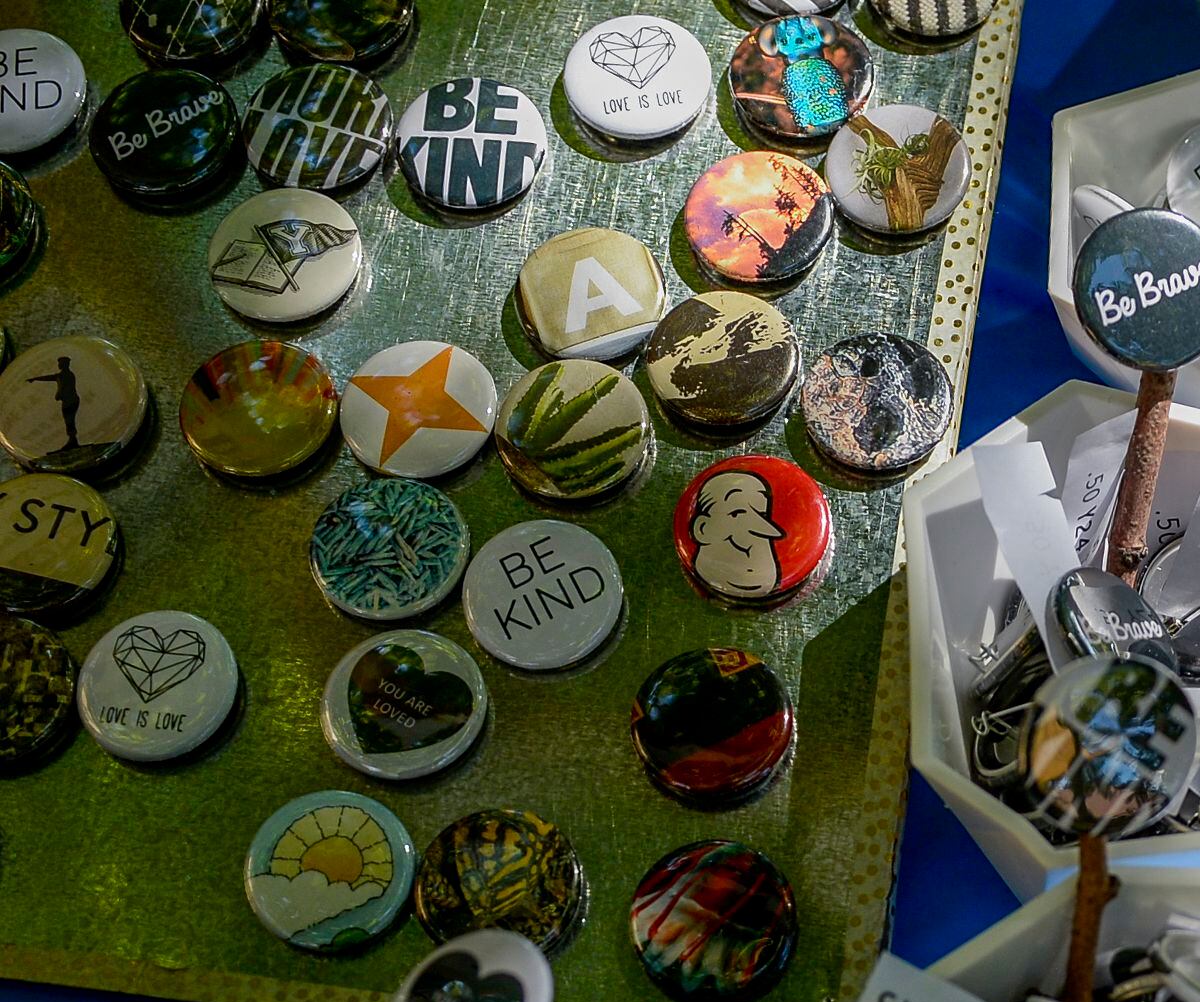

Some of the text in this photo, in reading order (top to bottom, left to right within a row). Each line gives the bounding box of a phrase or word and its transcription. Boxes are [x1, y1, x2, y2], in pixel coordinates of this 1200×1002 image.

[0, 80, 62, 114] ND
[423, 77, 519, 136] BE
[603, 90, 684, 114] LOVE IS LOVE
[108, 90, 224, 161] Be Brave
[564, 256, 643, 334] A
[1094, 288, 1137, 327] Be
[1075, 504, 1098, 552] Y24
[499, 536, 566, 591] BE
[493, 565, 605, 640] KIND
[1105, 611, 1163, 641] Brave
[373, 698, 416, 729] LOVED
[377, 679, 433, 717] YOU ARE
[100, 706, 187, 732] LOVE IS LOVE
